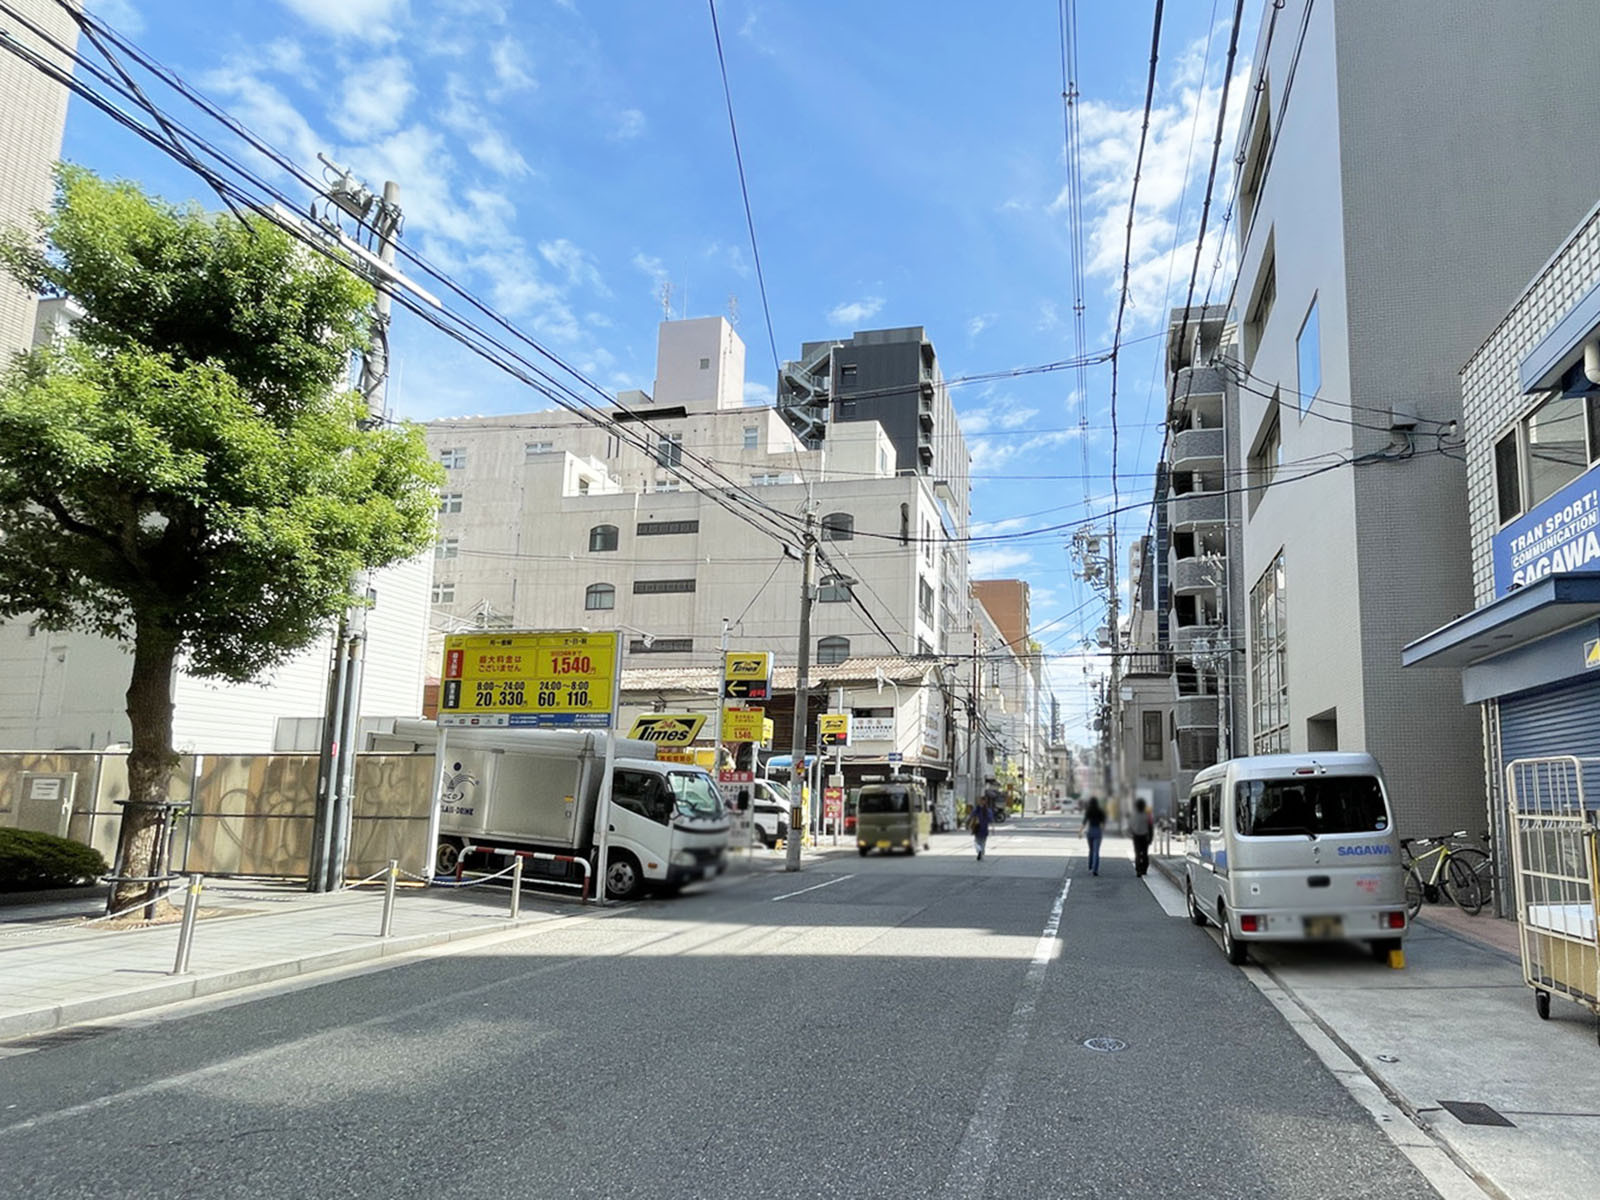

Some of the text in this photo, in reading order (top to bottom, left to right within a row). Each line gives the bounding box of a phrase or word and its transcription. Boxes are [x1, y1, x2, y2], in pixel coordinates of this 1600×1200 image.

[1512, 511, 1597, 568] COMMUNICATION
[1512, 531, 1600, 587] SAGAWA
[635, 719, 693, 742] Times
[1337, 844, 1393, 857] SAGAWA
